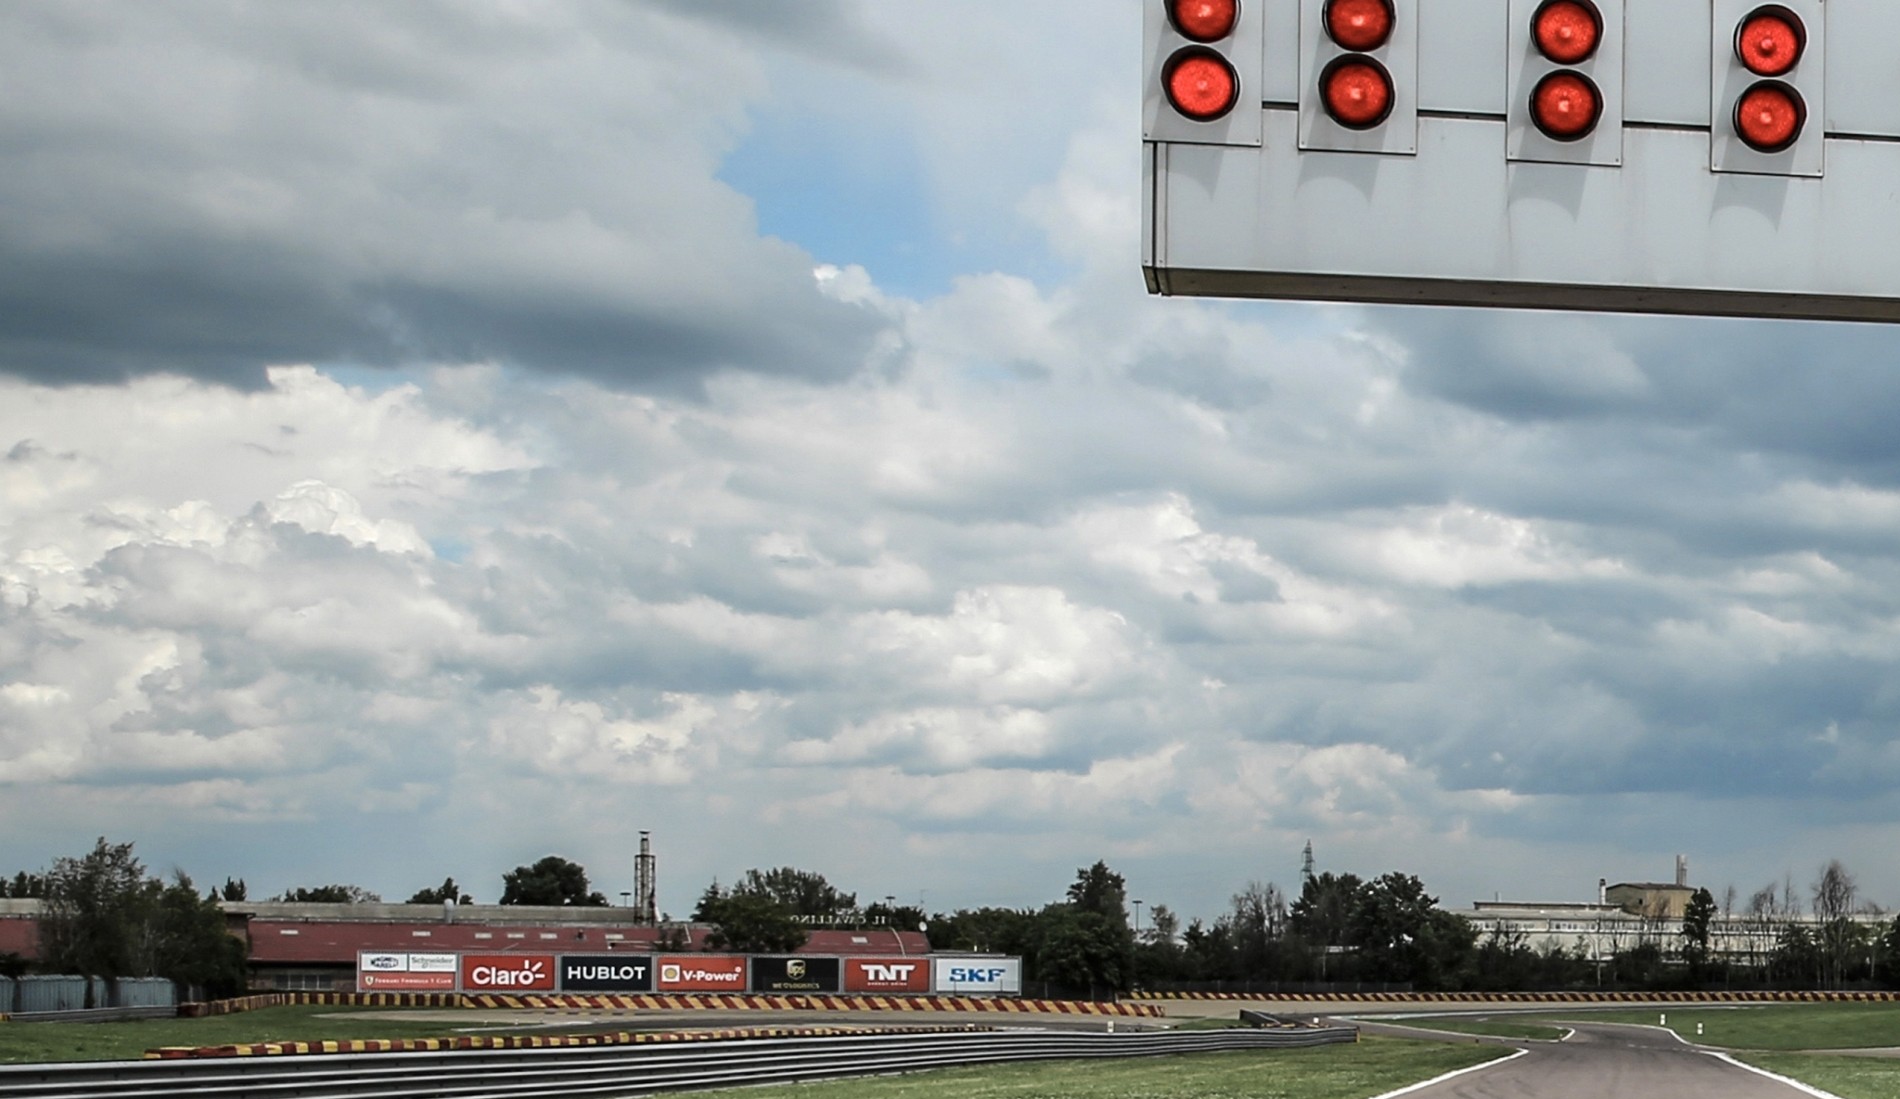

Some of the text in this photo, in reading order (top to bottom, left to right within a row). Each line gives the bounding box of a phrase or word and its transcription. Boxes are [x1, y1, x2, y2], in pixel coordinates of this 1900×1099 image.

[472, 966, 535, 985] Claro
[567, 965, 646, 980] HUBLOT
[682, 968, 739, 982] V-Power
[860, 964, 916, 981] TNT
[949, 968, 1005, 982] SKF
